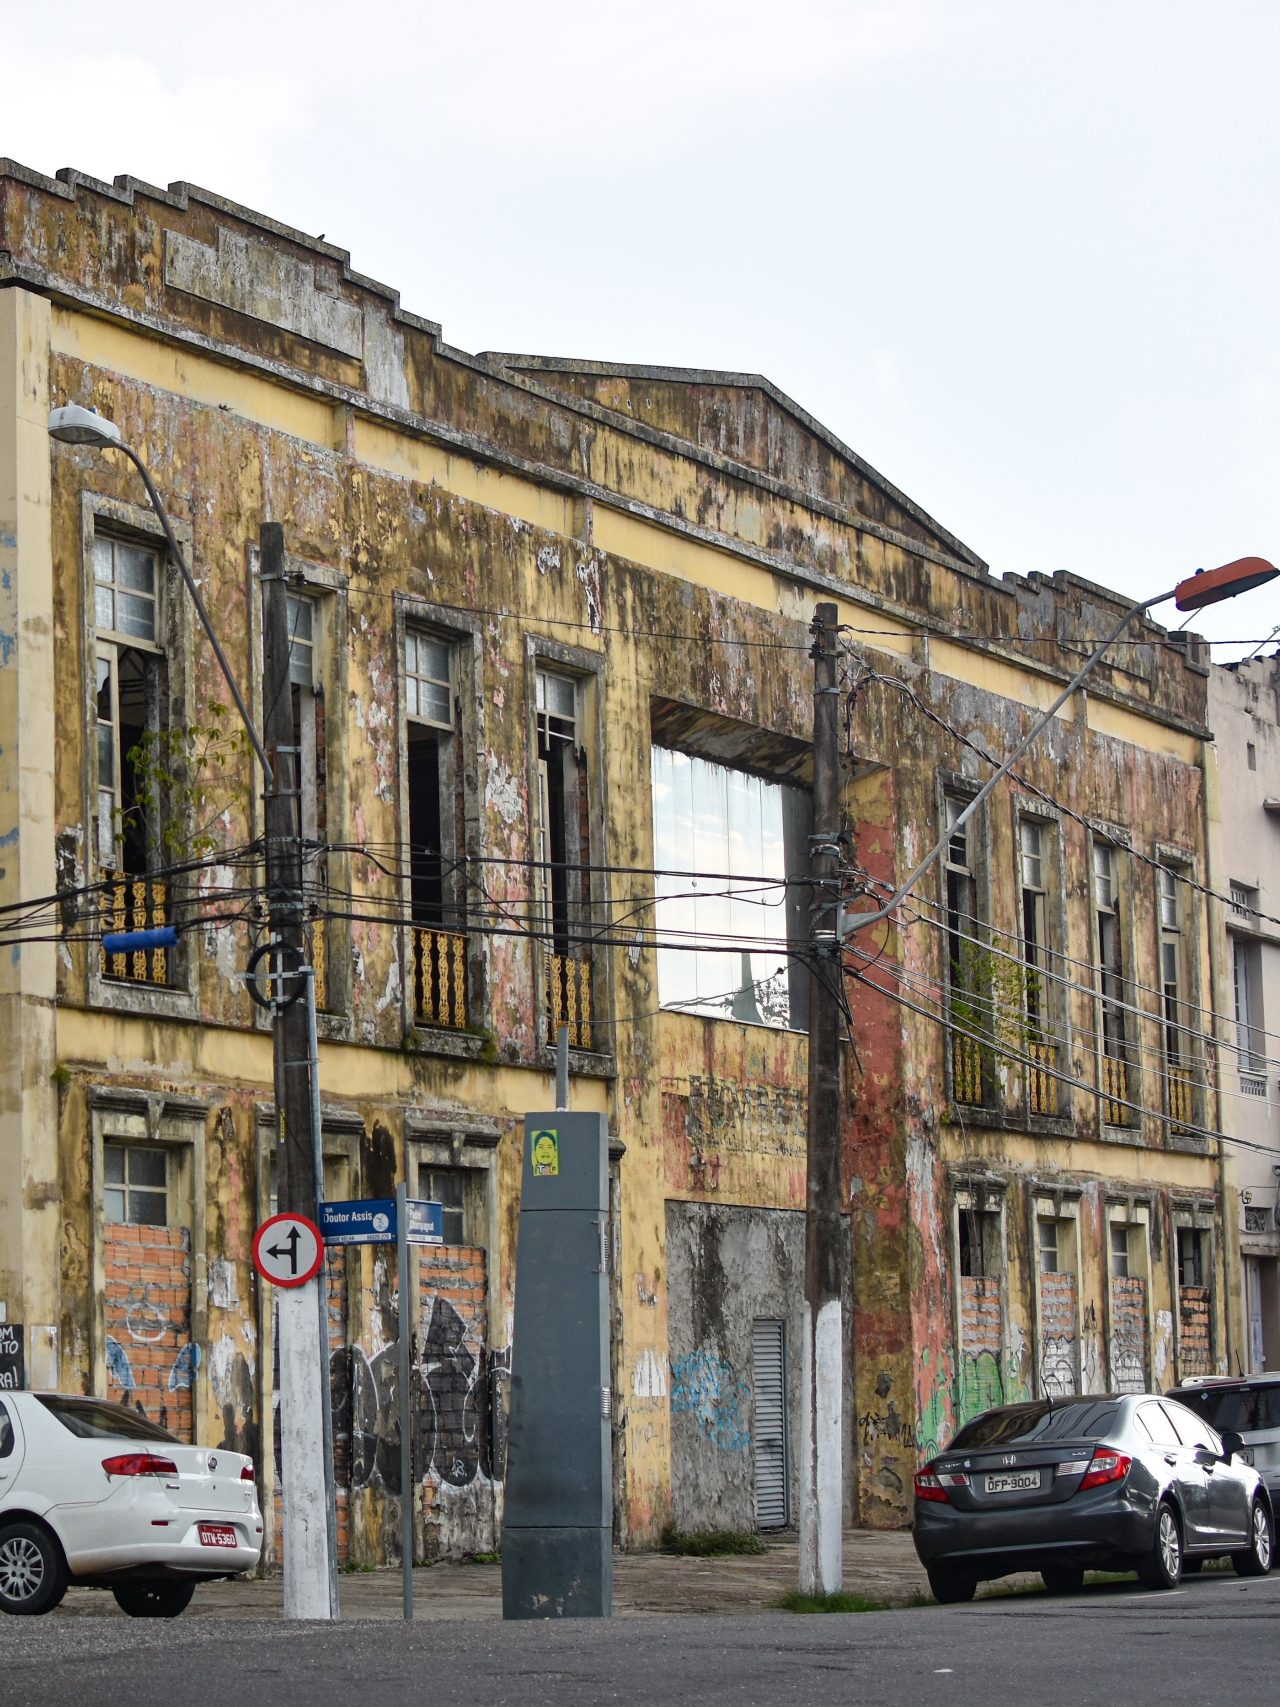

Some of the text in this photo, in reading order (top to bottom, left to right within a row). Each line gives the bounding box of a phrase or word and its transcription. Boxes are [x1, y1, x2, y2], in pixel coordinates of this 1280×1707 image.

[324, 1211, 373, 1223] Doutor Assis
[987, 1476, 1038, 1491] OFP-9004
[201, 1532, 236, 1545] OTW-5360
